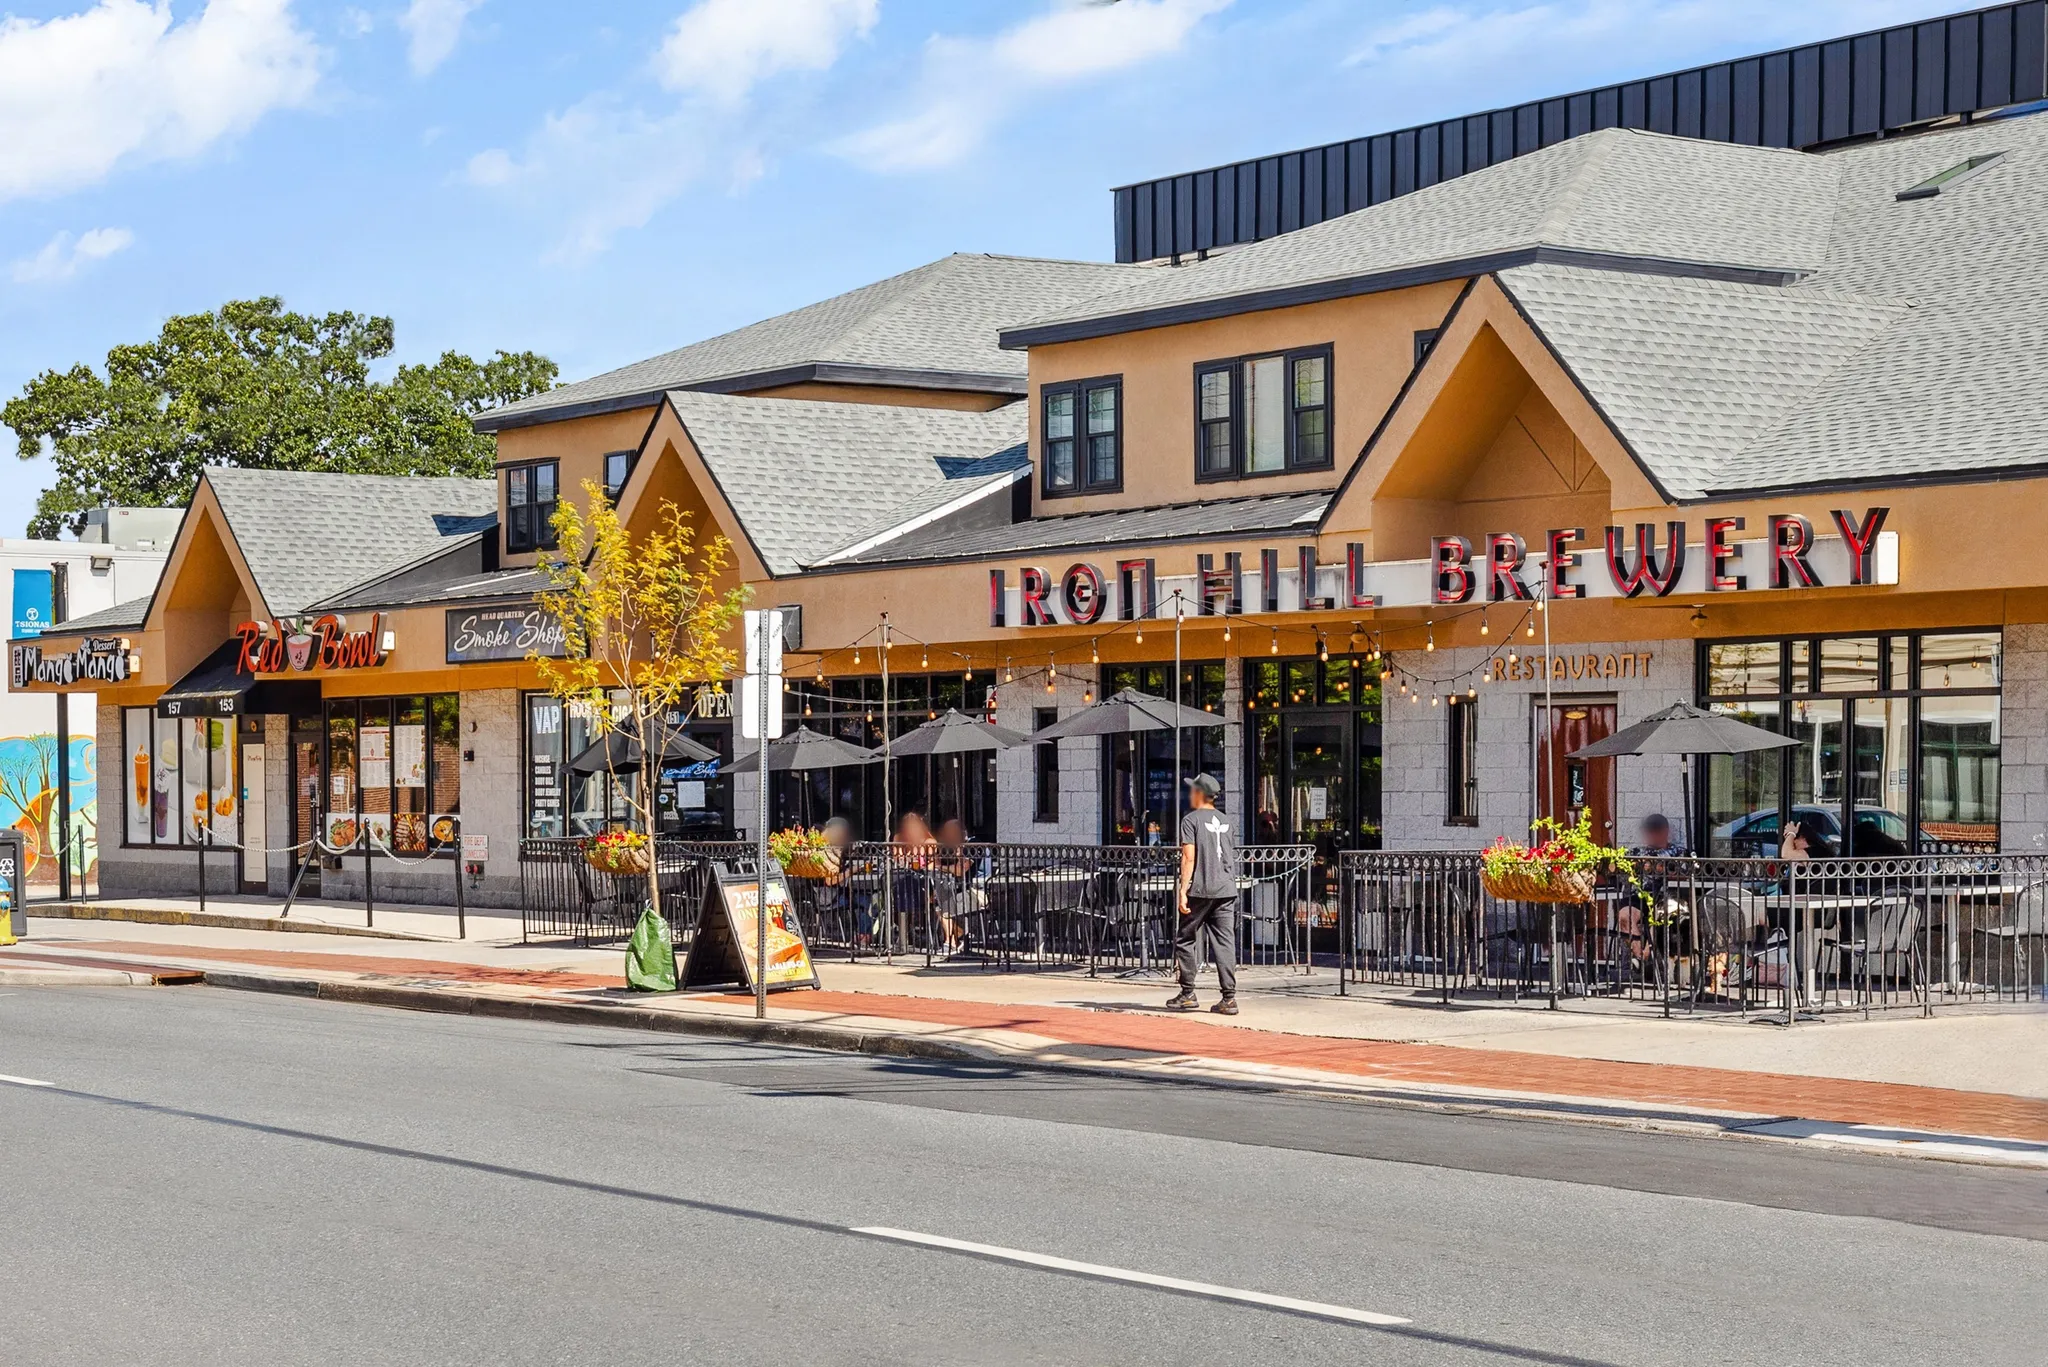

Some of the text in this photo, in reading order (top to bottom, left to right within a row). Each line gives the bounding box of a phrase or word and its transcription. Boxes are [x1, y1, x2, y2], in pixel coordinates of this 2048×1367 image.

[989, 506, 1891, 627] IRON HILL BREWERY
[15, 620, 50, 628] TSIONAS
[481, 610, 526, 621] HEAD QUARTERS
[453, 610, 567, 654] Smoke Shop
[92, 640, 117, 652] Dessert
[235, 612, 383, 676] Red Bowl
[24, 646, 74, 686] Mango
[76, 647, 126, 683] Mango
[1493, 652, 1654, 682] RESTAURANT
[167, 698, 234, 715] 157 153
[698, 693, 734, 718] OPEN
[667, 712, 679, 724] 151
[732, 891, 744, 909] 2
